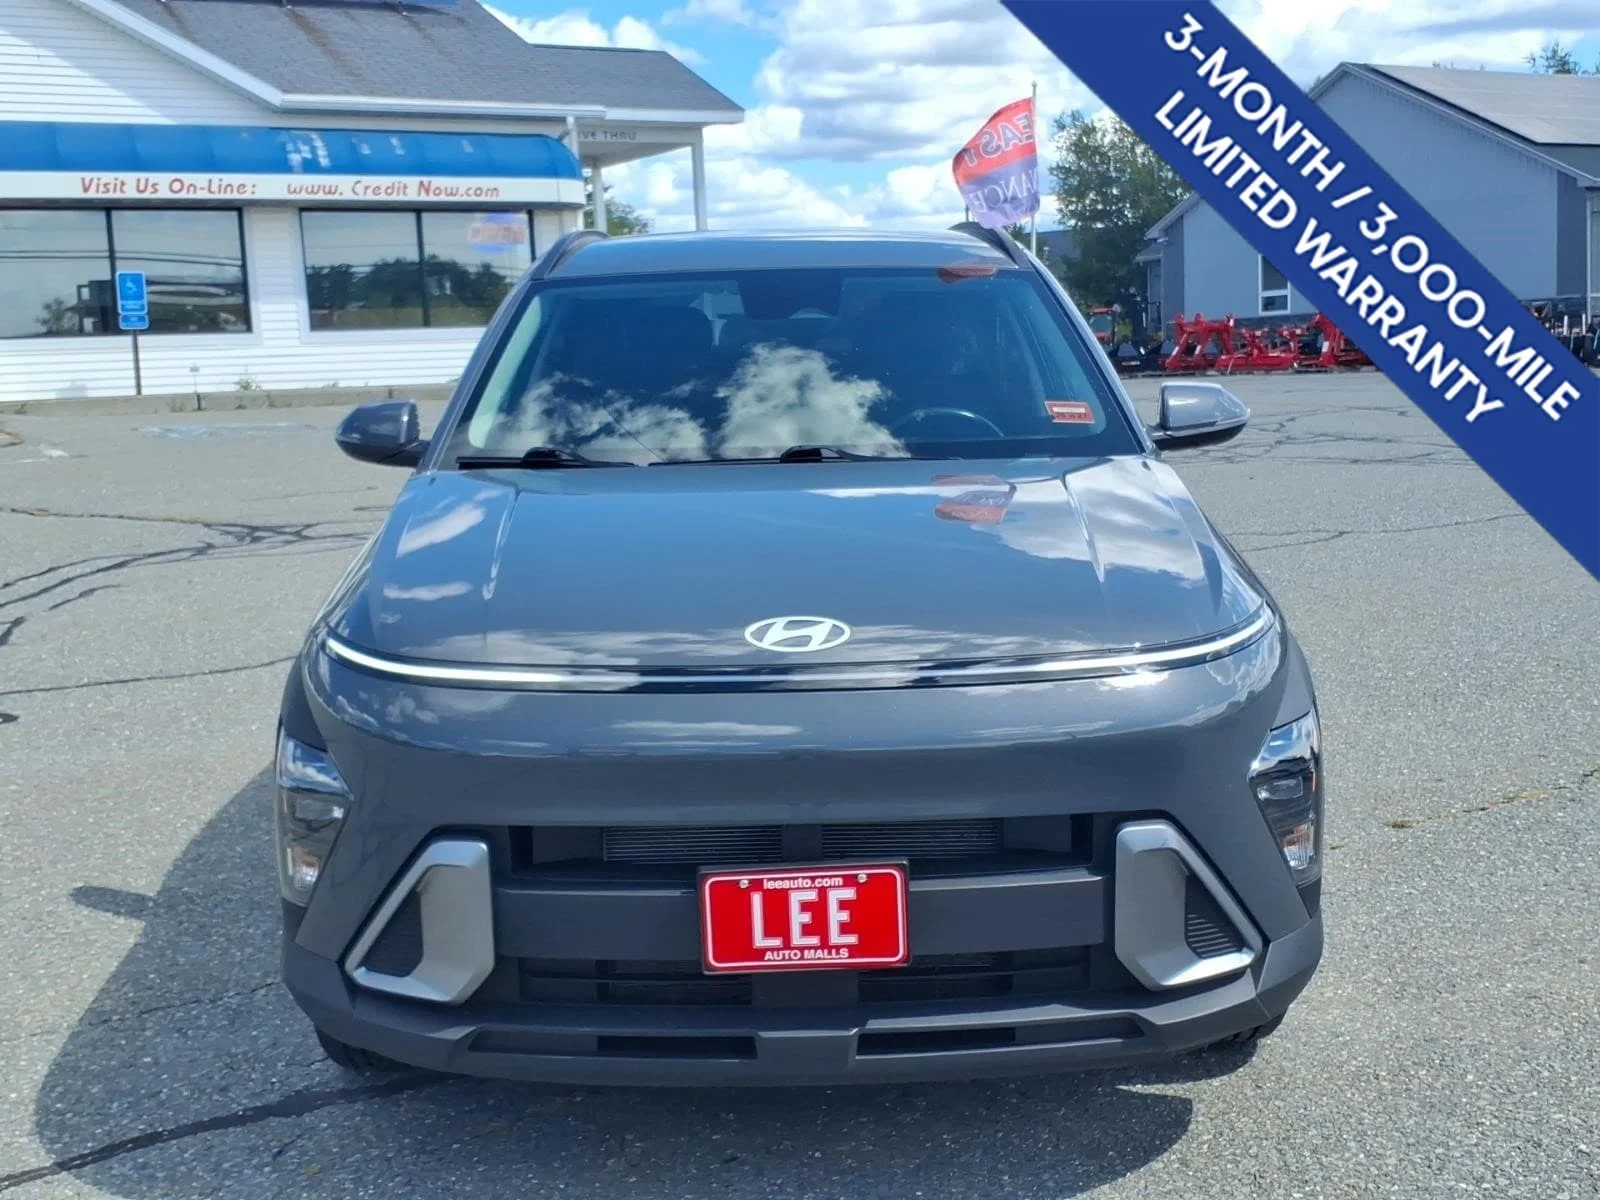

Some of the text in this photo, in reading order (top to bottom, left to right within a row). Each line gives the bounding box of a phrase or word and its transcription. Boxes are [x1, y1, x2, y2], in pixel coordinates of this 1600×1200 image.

[603, 130, 637, 140] THRU
[80, 177, 500, 198] Visit Us On-Line: www. Credit Now.com
[763, 877, 843, 890] leeauto.com
[750, 888, 859, 948] LEE
[764, 948, 849, 961] AUTO MALLS
